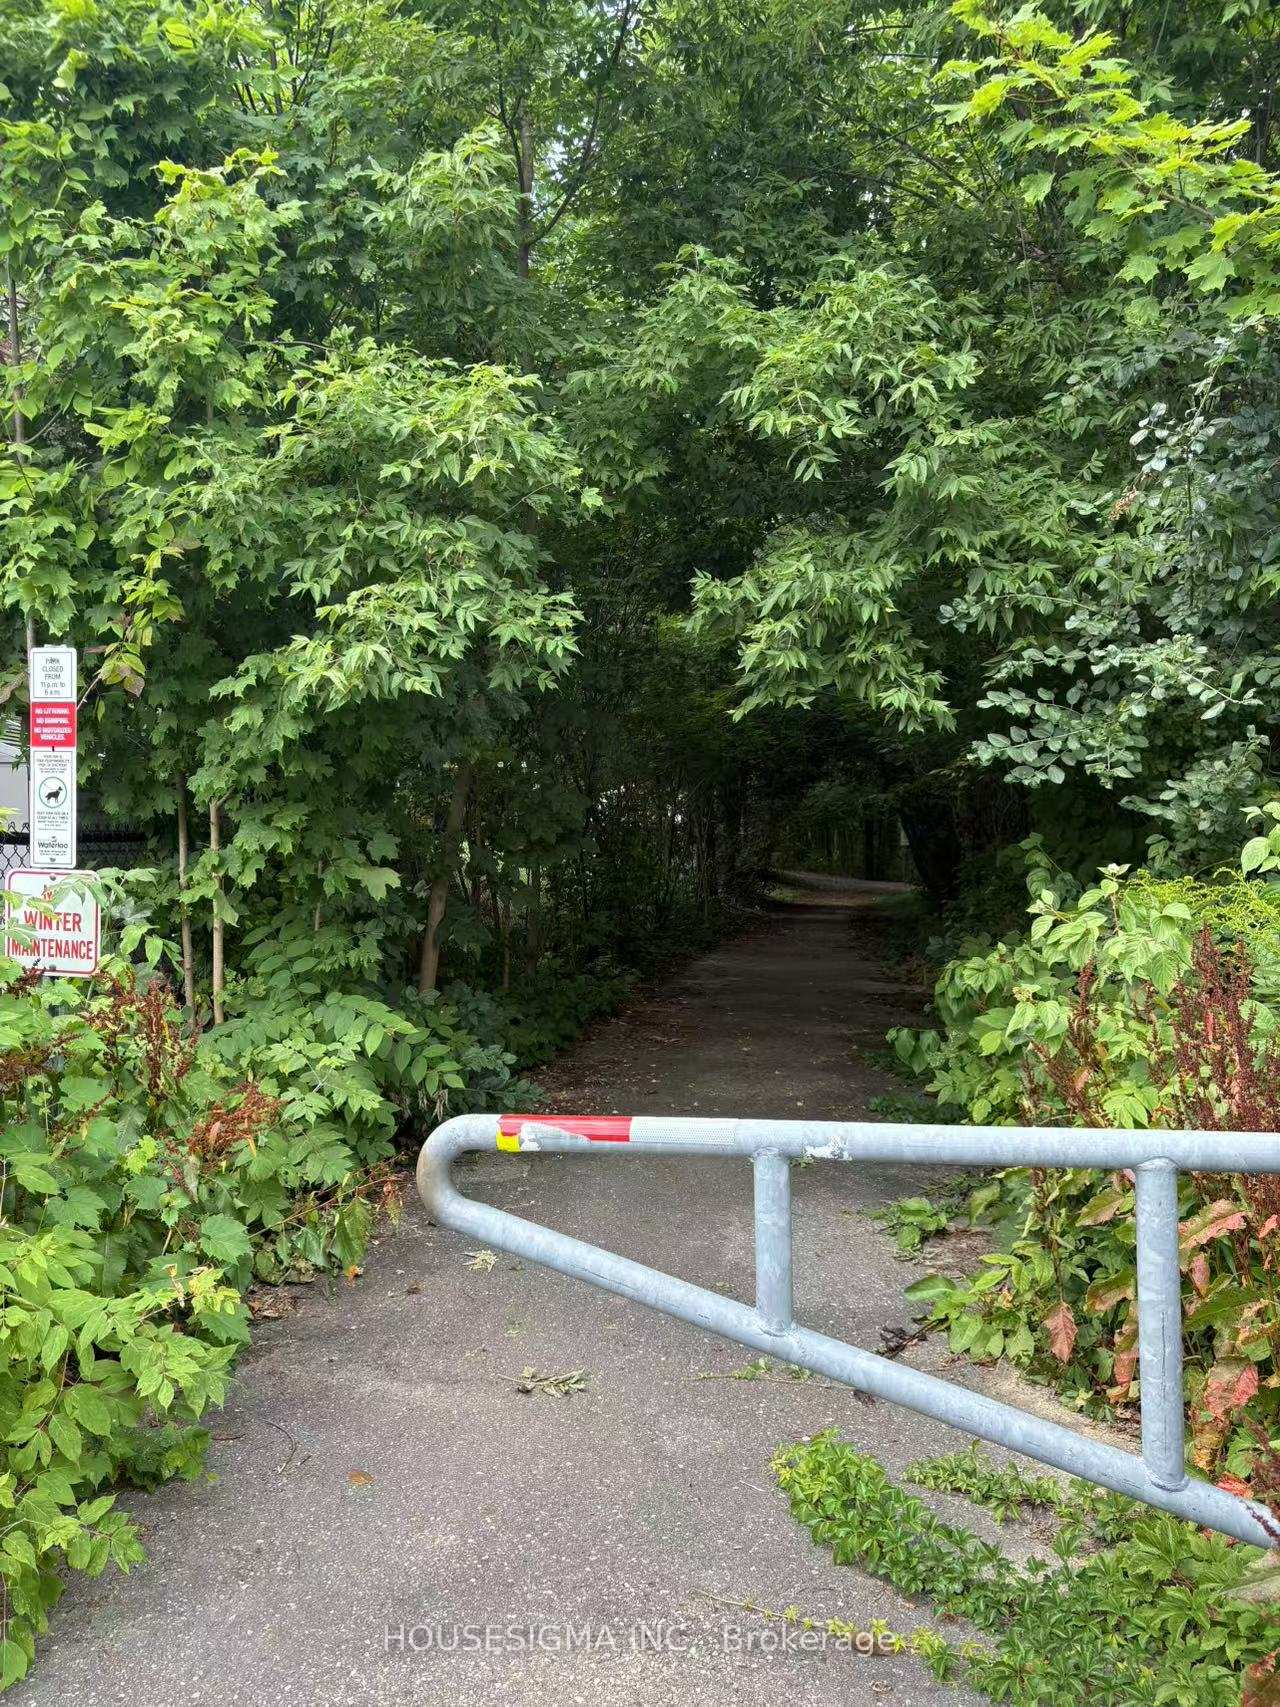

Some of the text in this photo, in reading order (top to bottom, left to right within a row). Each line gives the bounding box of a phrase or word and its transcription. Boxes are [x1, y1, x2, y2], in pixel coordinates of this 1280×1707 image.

[42, 665, 64, 673] CLOSED
[44, 673, 61, 681] FROM
[24, 910, 82, 932] WINTER
